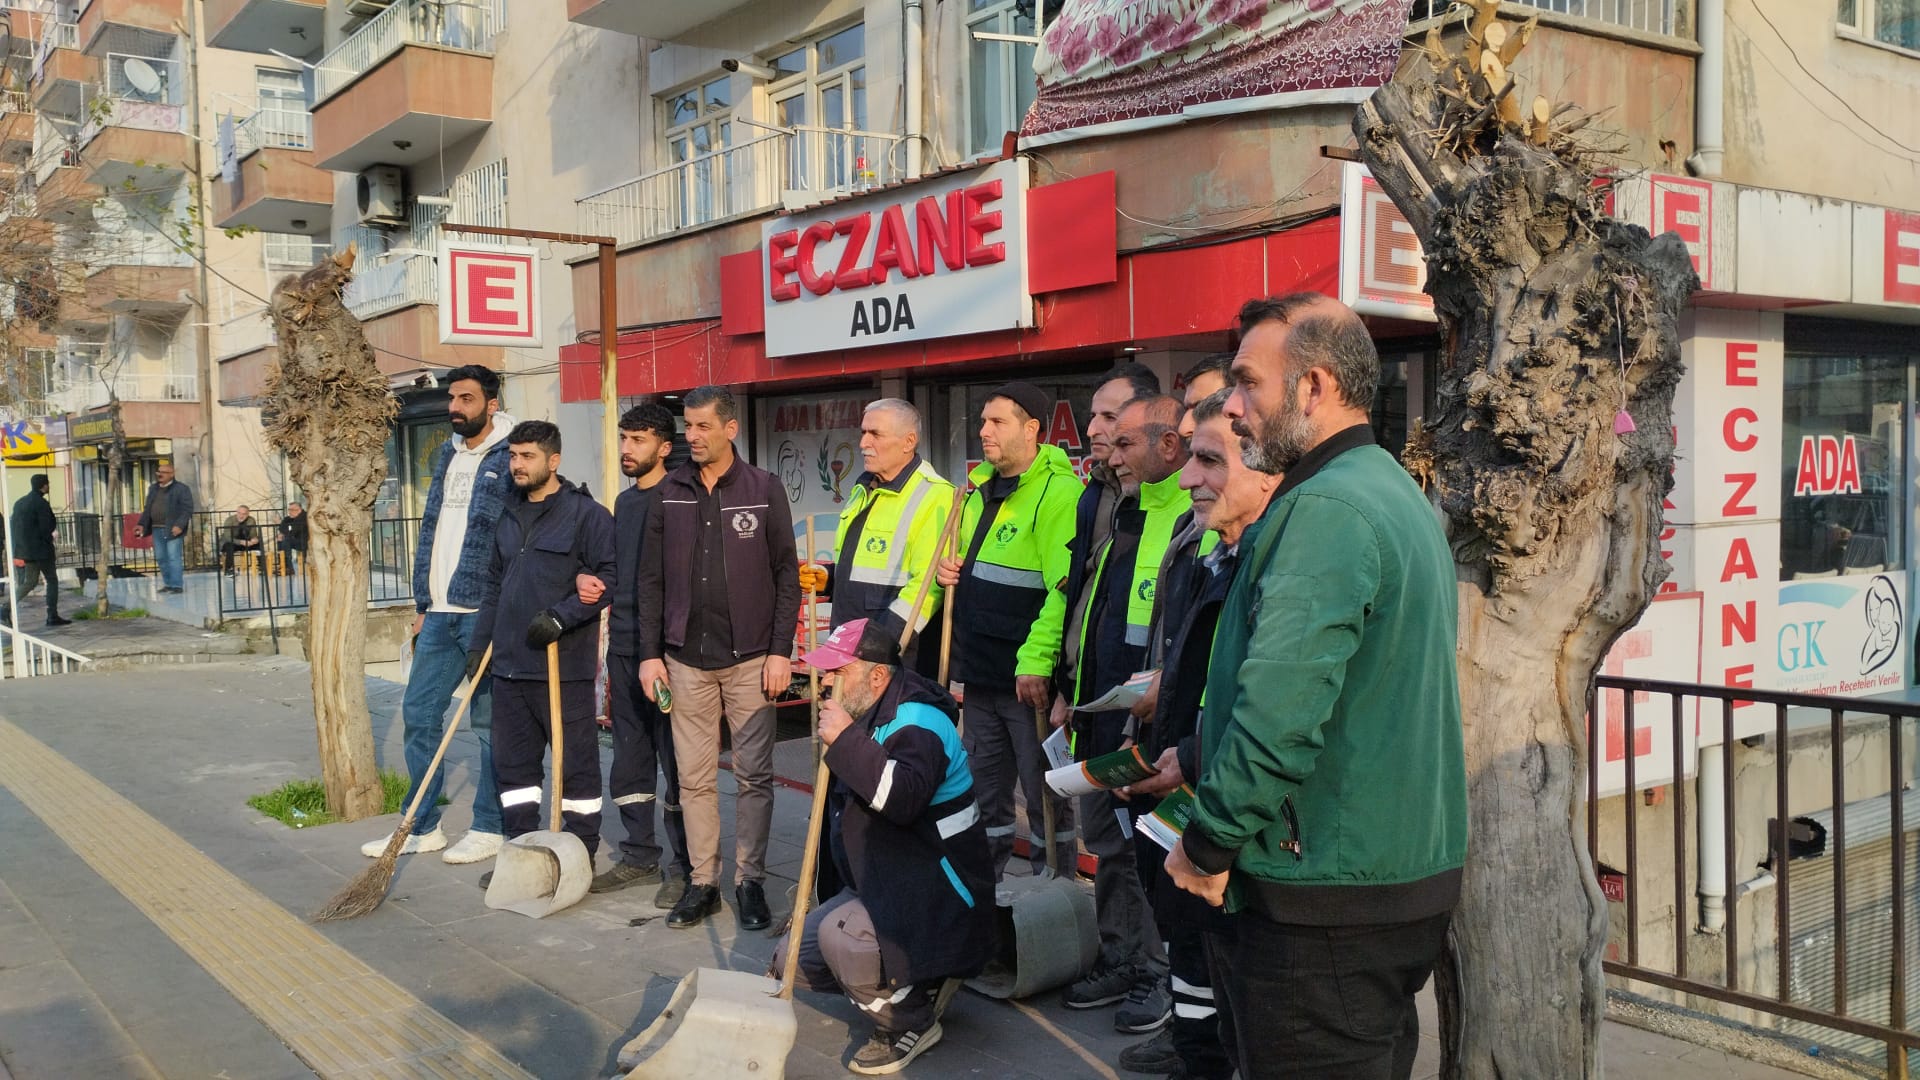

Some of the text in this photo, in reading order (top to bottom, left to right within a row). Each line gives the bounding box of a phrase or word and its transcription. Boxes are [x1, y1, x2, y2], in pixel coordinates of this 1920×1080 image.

[769, 179, 1005, 302] ECZANE
[1374, 200, 1418, 287] E
[467, 264, 519, 326] E
[850, 293, 915, 338] ADA
[773, 405, 809, 432] ADA
[1795, 435, 1862, 496] ADA
[1720, 342, 1759, 710] ECZANE
[1777, 620, 1829, 672] GK
[1606, 630, 1652, 762] E
[1839, 676, 1877, 694] Reçeteleri
[1878, 671, 1901, 686] Verilir
